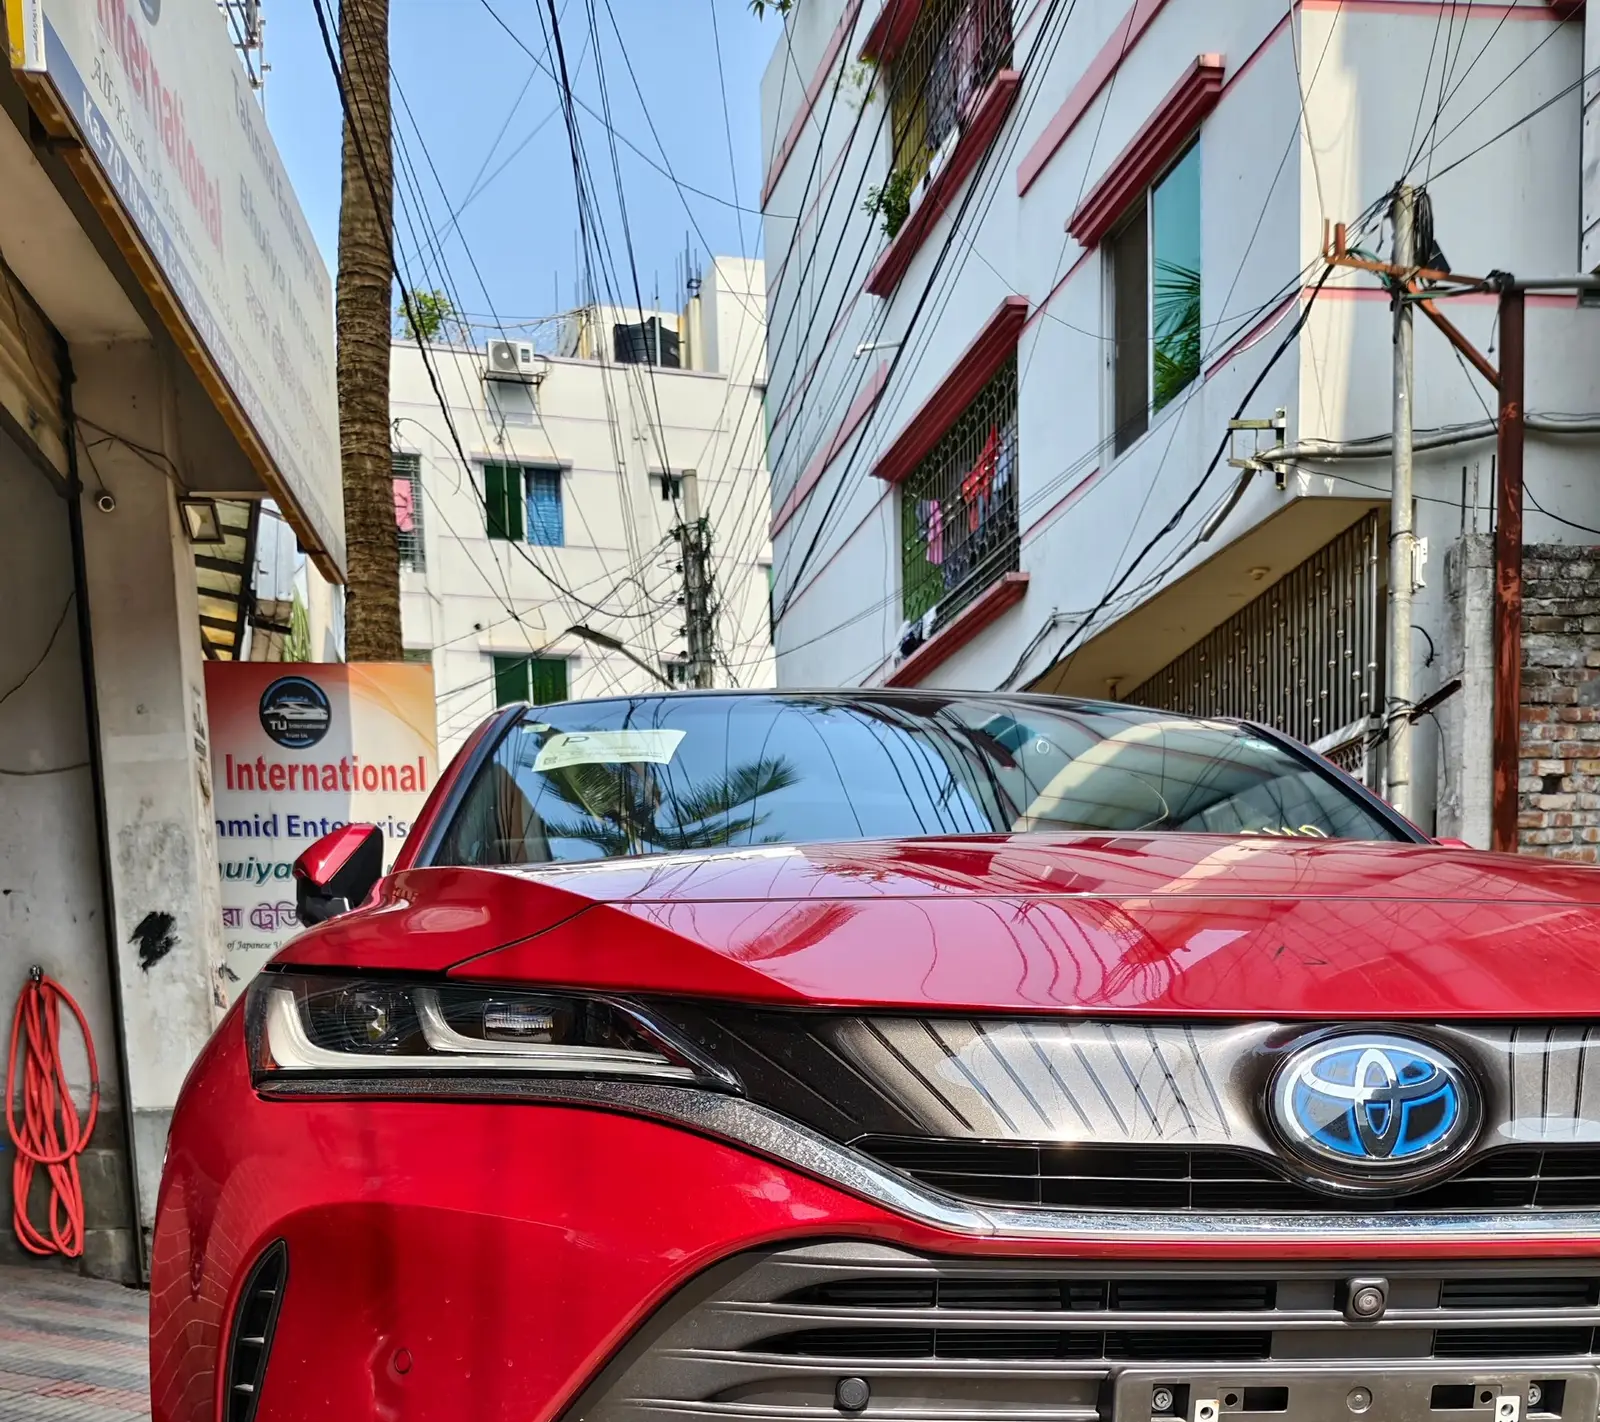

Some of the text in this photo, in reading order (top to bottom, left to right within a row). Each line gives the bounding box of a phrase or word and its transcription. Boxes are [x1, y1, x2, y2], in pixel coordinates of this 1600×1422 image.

[91, 56, 114, 108] All
[114, 96, 147, 173] Kinds
[151, 168, 163, 202] of
[230, 63, 275, 203] Tahmid
[82, 90, 126, 195] Ka-70,
[127, 170, 166, 262] Norda,
[269, 719, 288, 731] TU
[225, 753, 427, 792] International
[218, 856, 293, 885] uiya
[227, 940, 236, 952] of
